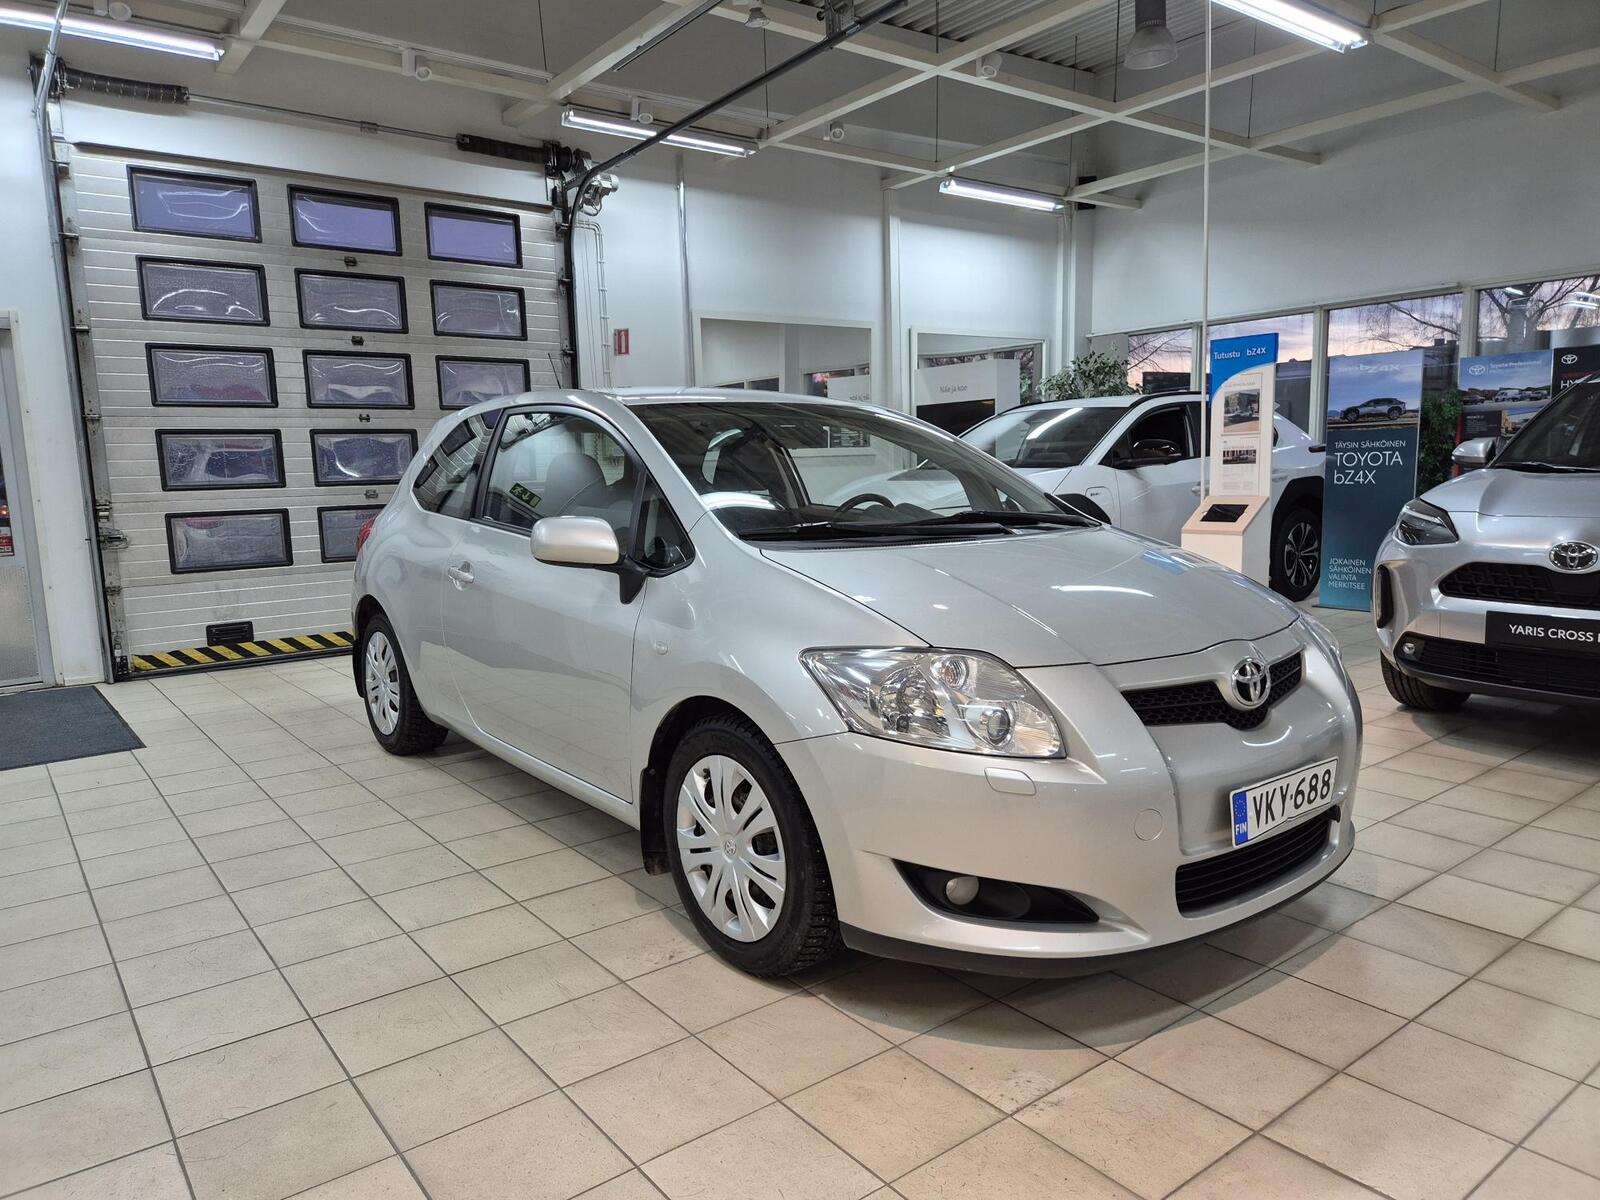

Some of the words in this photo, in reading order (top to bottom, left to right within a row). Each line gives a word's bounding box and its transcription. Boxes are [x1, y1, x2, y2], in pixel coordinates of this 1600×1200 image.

[1213, 351, 1240, 360] Tutustu
[1246, 347, 1266, 356] bZ4X
[1335, 441, 1359, 449] TÄYSIN
[1360, 440, 1406, 449] SÄHKÖINEN
[1334, 451, 1403, 467] TOYOTA
[1334, 469, 1376, 485] bZ4X
[1329, 558, 1366, 566] JOKAINEN
[1328, 565, 1372, 575] SÄHKÖINEN
[1328, 573, 1357, 581] VALINTA
[1328, 581, 1367, 590] MERKITSEE
[1509, 623, 1545, 637] YARIS
[1548, 628, 1594, 642] CROSS
[1252, 768, 1332, 829] VKY-688
[1235, 822, 1247, 836] FIN
